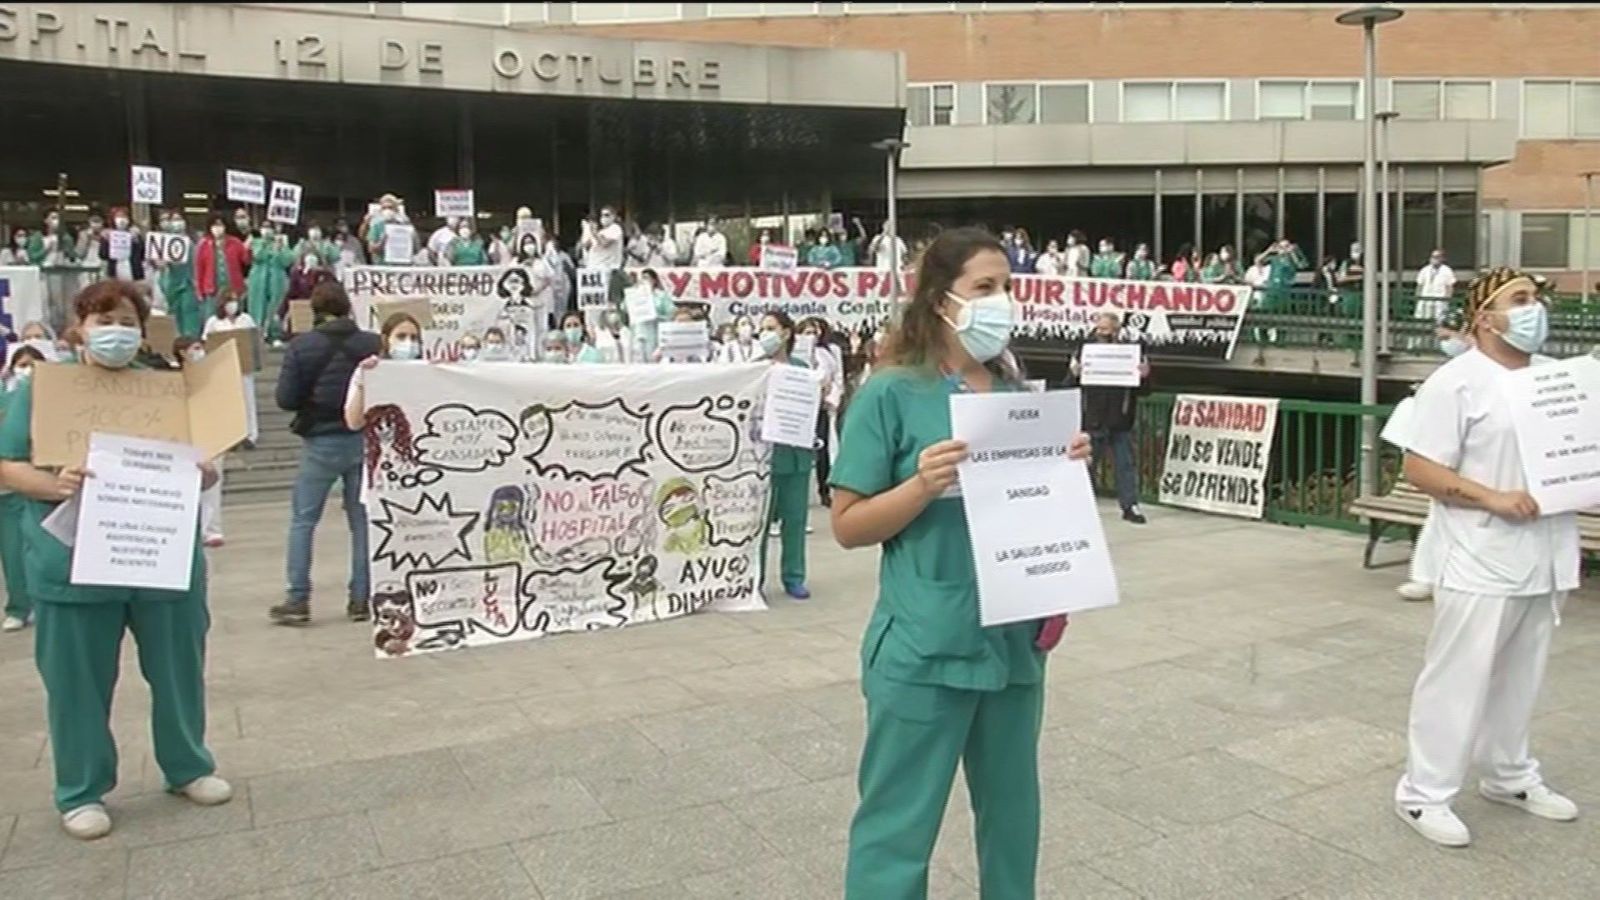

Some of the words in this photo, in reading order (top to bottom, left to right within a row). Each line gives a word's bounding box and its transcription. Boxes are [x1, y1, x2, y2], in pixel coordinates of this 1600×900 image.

[274, 34, 327, 67] 12
[380, 38, 443, 75] DE
[493, 48, 721, 90] OCTUBRE
[147, 235, 186, 261] NO
[352, 270, 493, 297] PRECARIEDAD
[699, 271, 849, 299] MOTIVOS
[1012, 277, 1065, 305] UIR
[1073, 281, 1236, 313] LUCHANDO
[837, 299, 892, 316] Contr
[1021, 304, 1103, 324] Hospitale
[1007, 408, 1040, 420] FUERA
[1174, 400, 1194, 427] La
[1194, 401, 1267, 433] SANIDAD
[971, 450, 989, 462] LAS
[990, 448, 1041, 461] EMPRESAS
[1042, 445, 1055, 456] DE
[1056, 445, 1067, 455] LA
[1168, 434, 1192, 462] NO
[1192, 440, 1213, 464] se
[118, 484, 132, 492] NO
[1006, 485, 1049, 499] SANIDAD
[1163, 471, 1183, 495] se
[543, 491, 574, 512] NO
[541, 512, 626, 547] HOSPITAL
[996, 550, 1009, 562] LA
[1010, 546, 1043, 560] SALUD
[1044, 543, 1059, 555] NO
[1060, 542, 1074, 552] ES
[1075, 540, 1090, 551] UN
[1025, 560, 1071, 576] NEGOCIO
